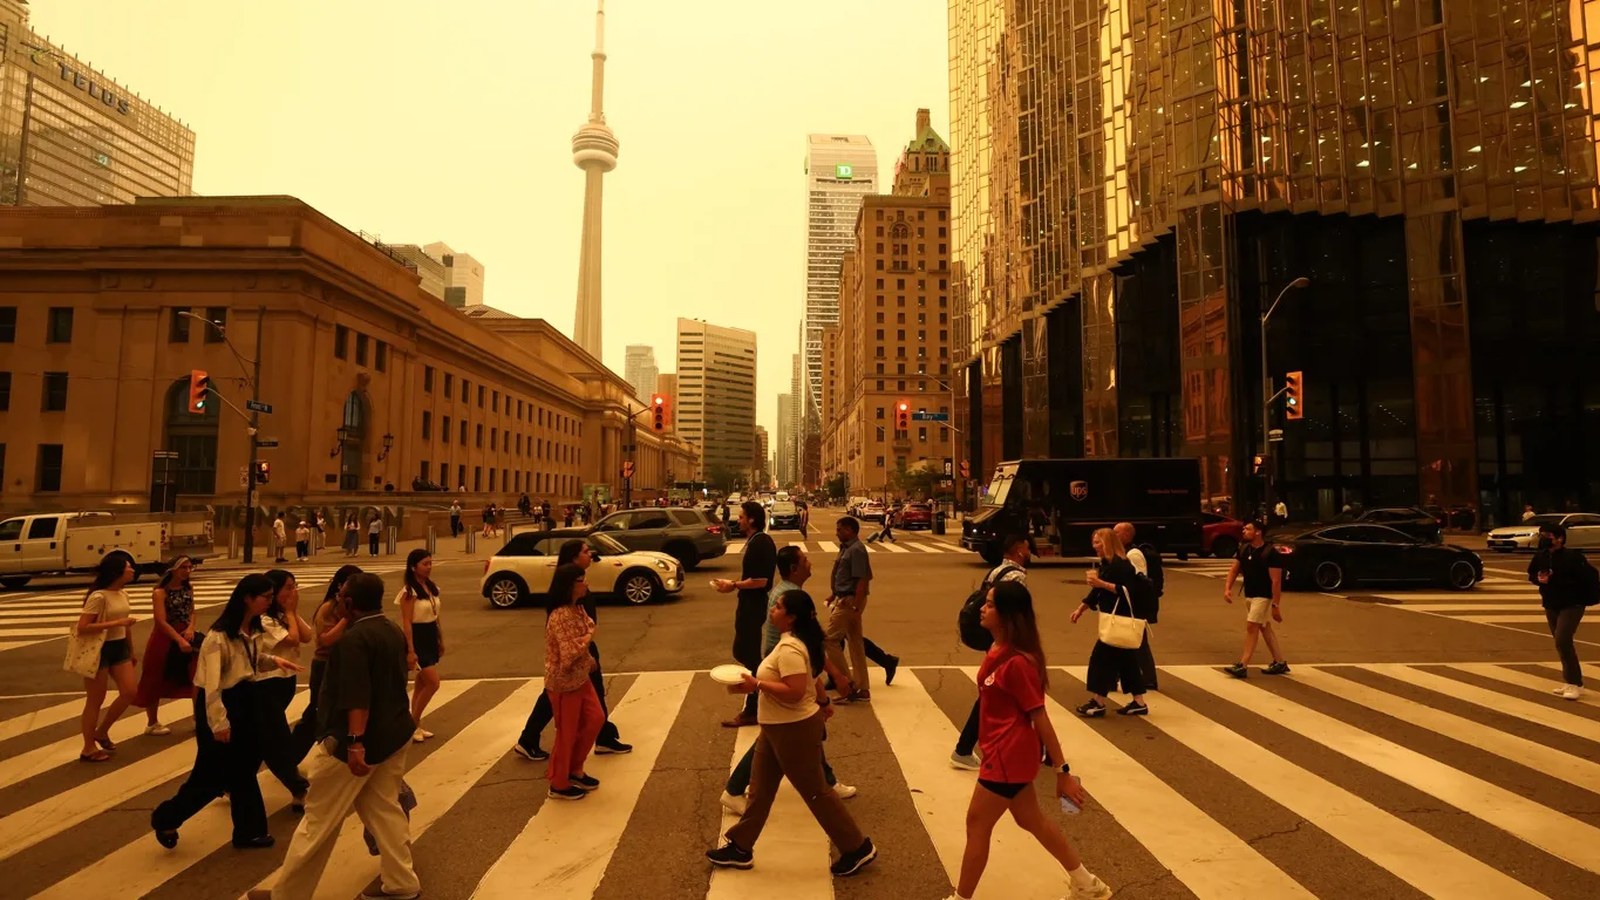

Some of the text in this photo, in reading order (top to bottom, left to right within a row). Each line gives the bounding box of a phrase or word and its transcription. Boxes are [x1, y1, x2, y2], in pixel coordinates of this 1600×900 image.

[57, 61, 129, 115] TELUS
[838, 165, 852, 177] TD
[921, 413, 934, 422] Bay
